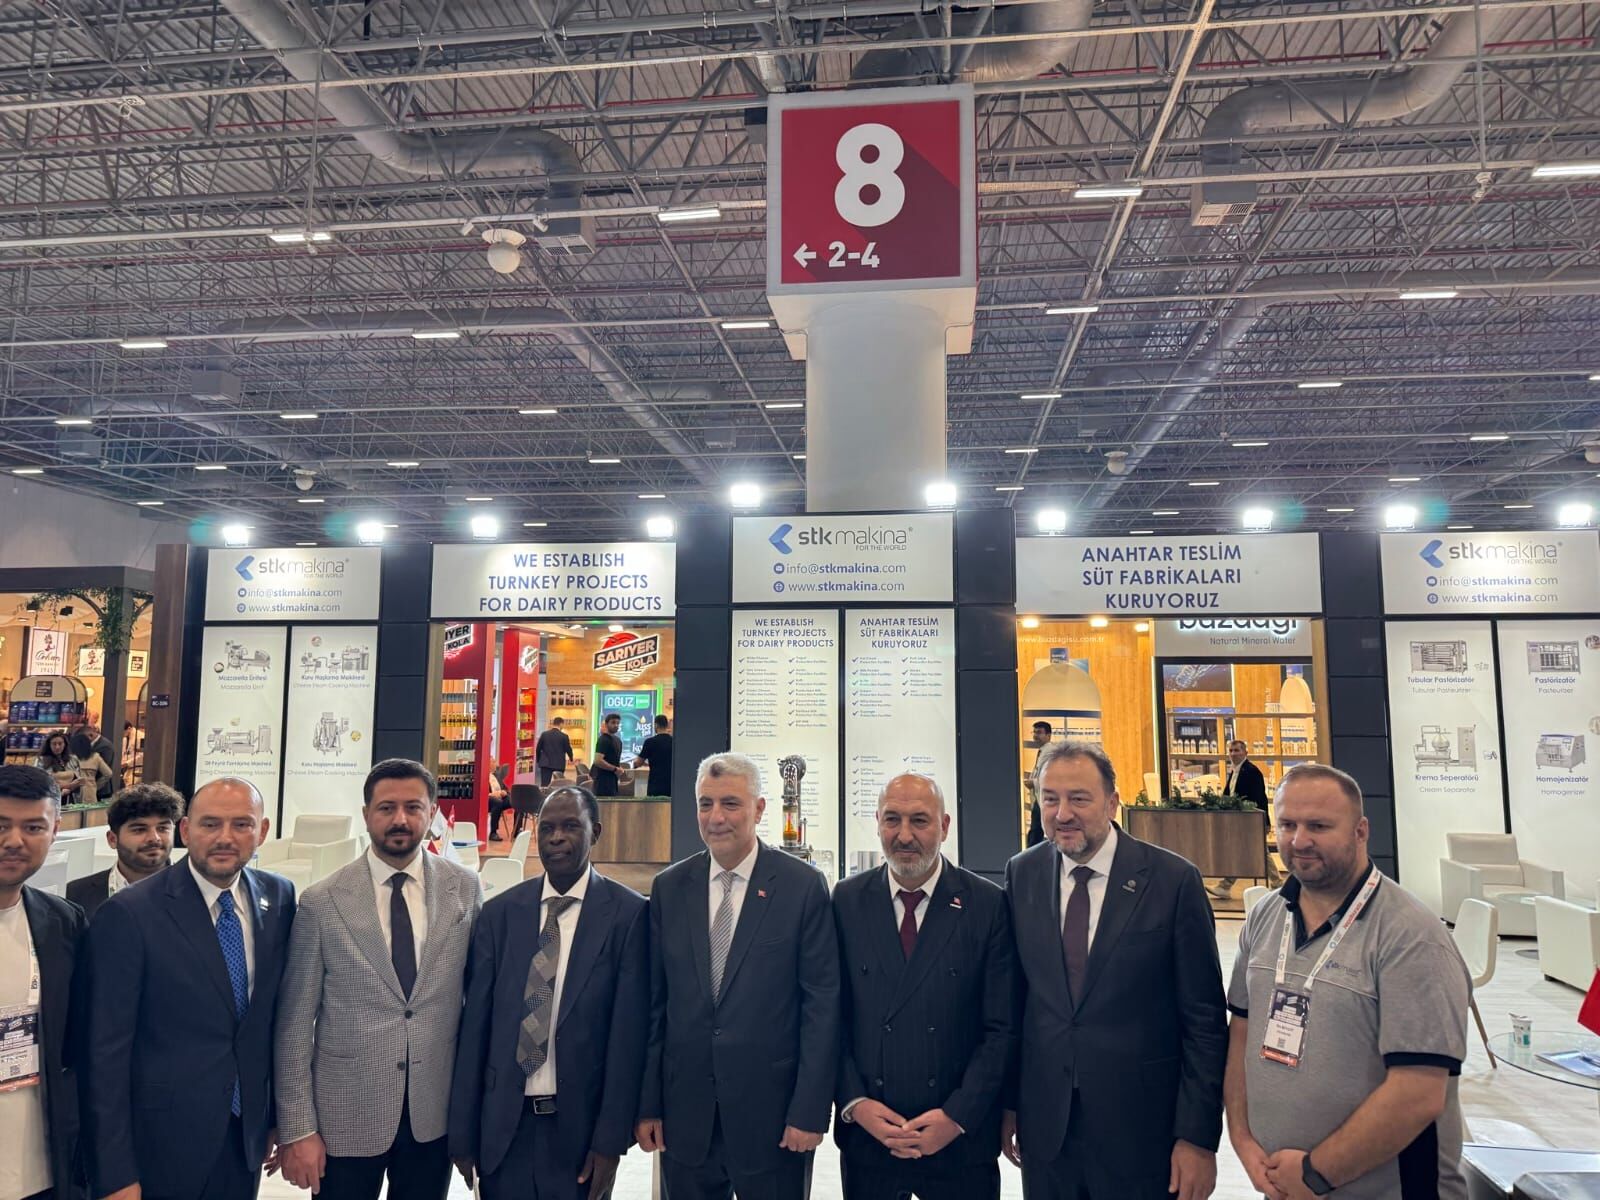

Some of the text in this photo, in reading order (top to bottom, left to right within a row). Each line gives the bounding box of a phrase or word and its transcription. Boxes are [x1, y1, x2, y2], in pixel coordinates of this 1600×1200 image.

[834, 122, 906, 228] 8
[828, 240, 880, 269] 2-4
[1082, 542, 1242, 563] ANAHTAR TESLİM
[513, 553, 625, 568] WE ESTABLISH
[786, 562, 906, 574] info@stkmakina.com
[1082, 565, 1241, 586] SÜT FABRİKALARI
[488, 574, 649, 590] TURNKEY PROJECTS
[788, 581, 905, 592] www.stkmakina.com
[479, 595, 662, 612] FOR DAIRY PRODUCTS
[1105, 592, 1220, 609] KURUYORUZ
[1442, 592, 1559, 603] www.stkmakina.com
[248, 602, 341, 612] www.stkmakina.com
[754, 618, 814, 627] WE ESTABLISH
[860, 616, 939, 626] ANAHTAR TESLİM
[742, 629, 827, 637] TURNKEY PROJECTS
[860, 627, 939, 637] SÜT FABRİKALARI
[447, 638, 470, 650] KOLA
[737, 639, 834, 648] FOR DAIRY PRODUCTS
[871, 640, 928, 648] KURUYORUZ
[1210, 637, 1296, 645] Natural Mineral Water
[596, 639, 656, 667] SARIYER
[627, 655, 655, 670] KOLA
